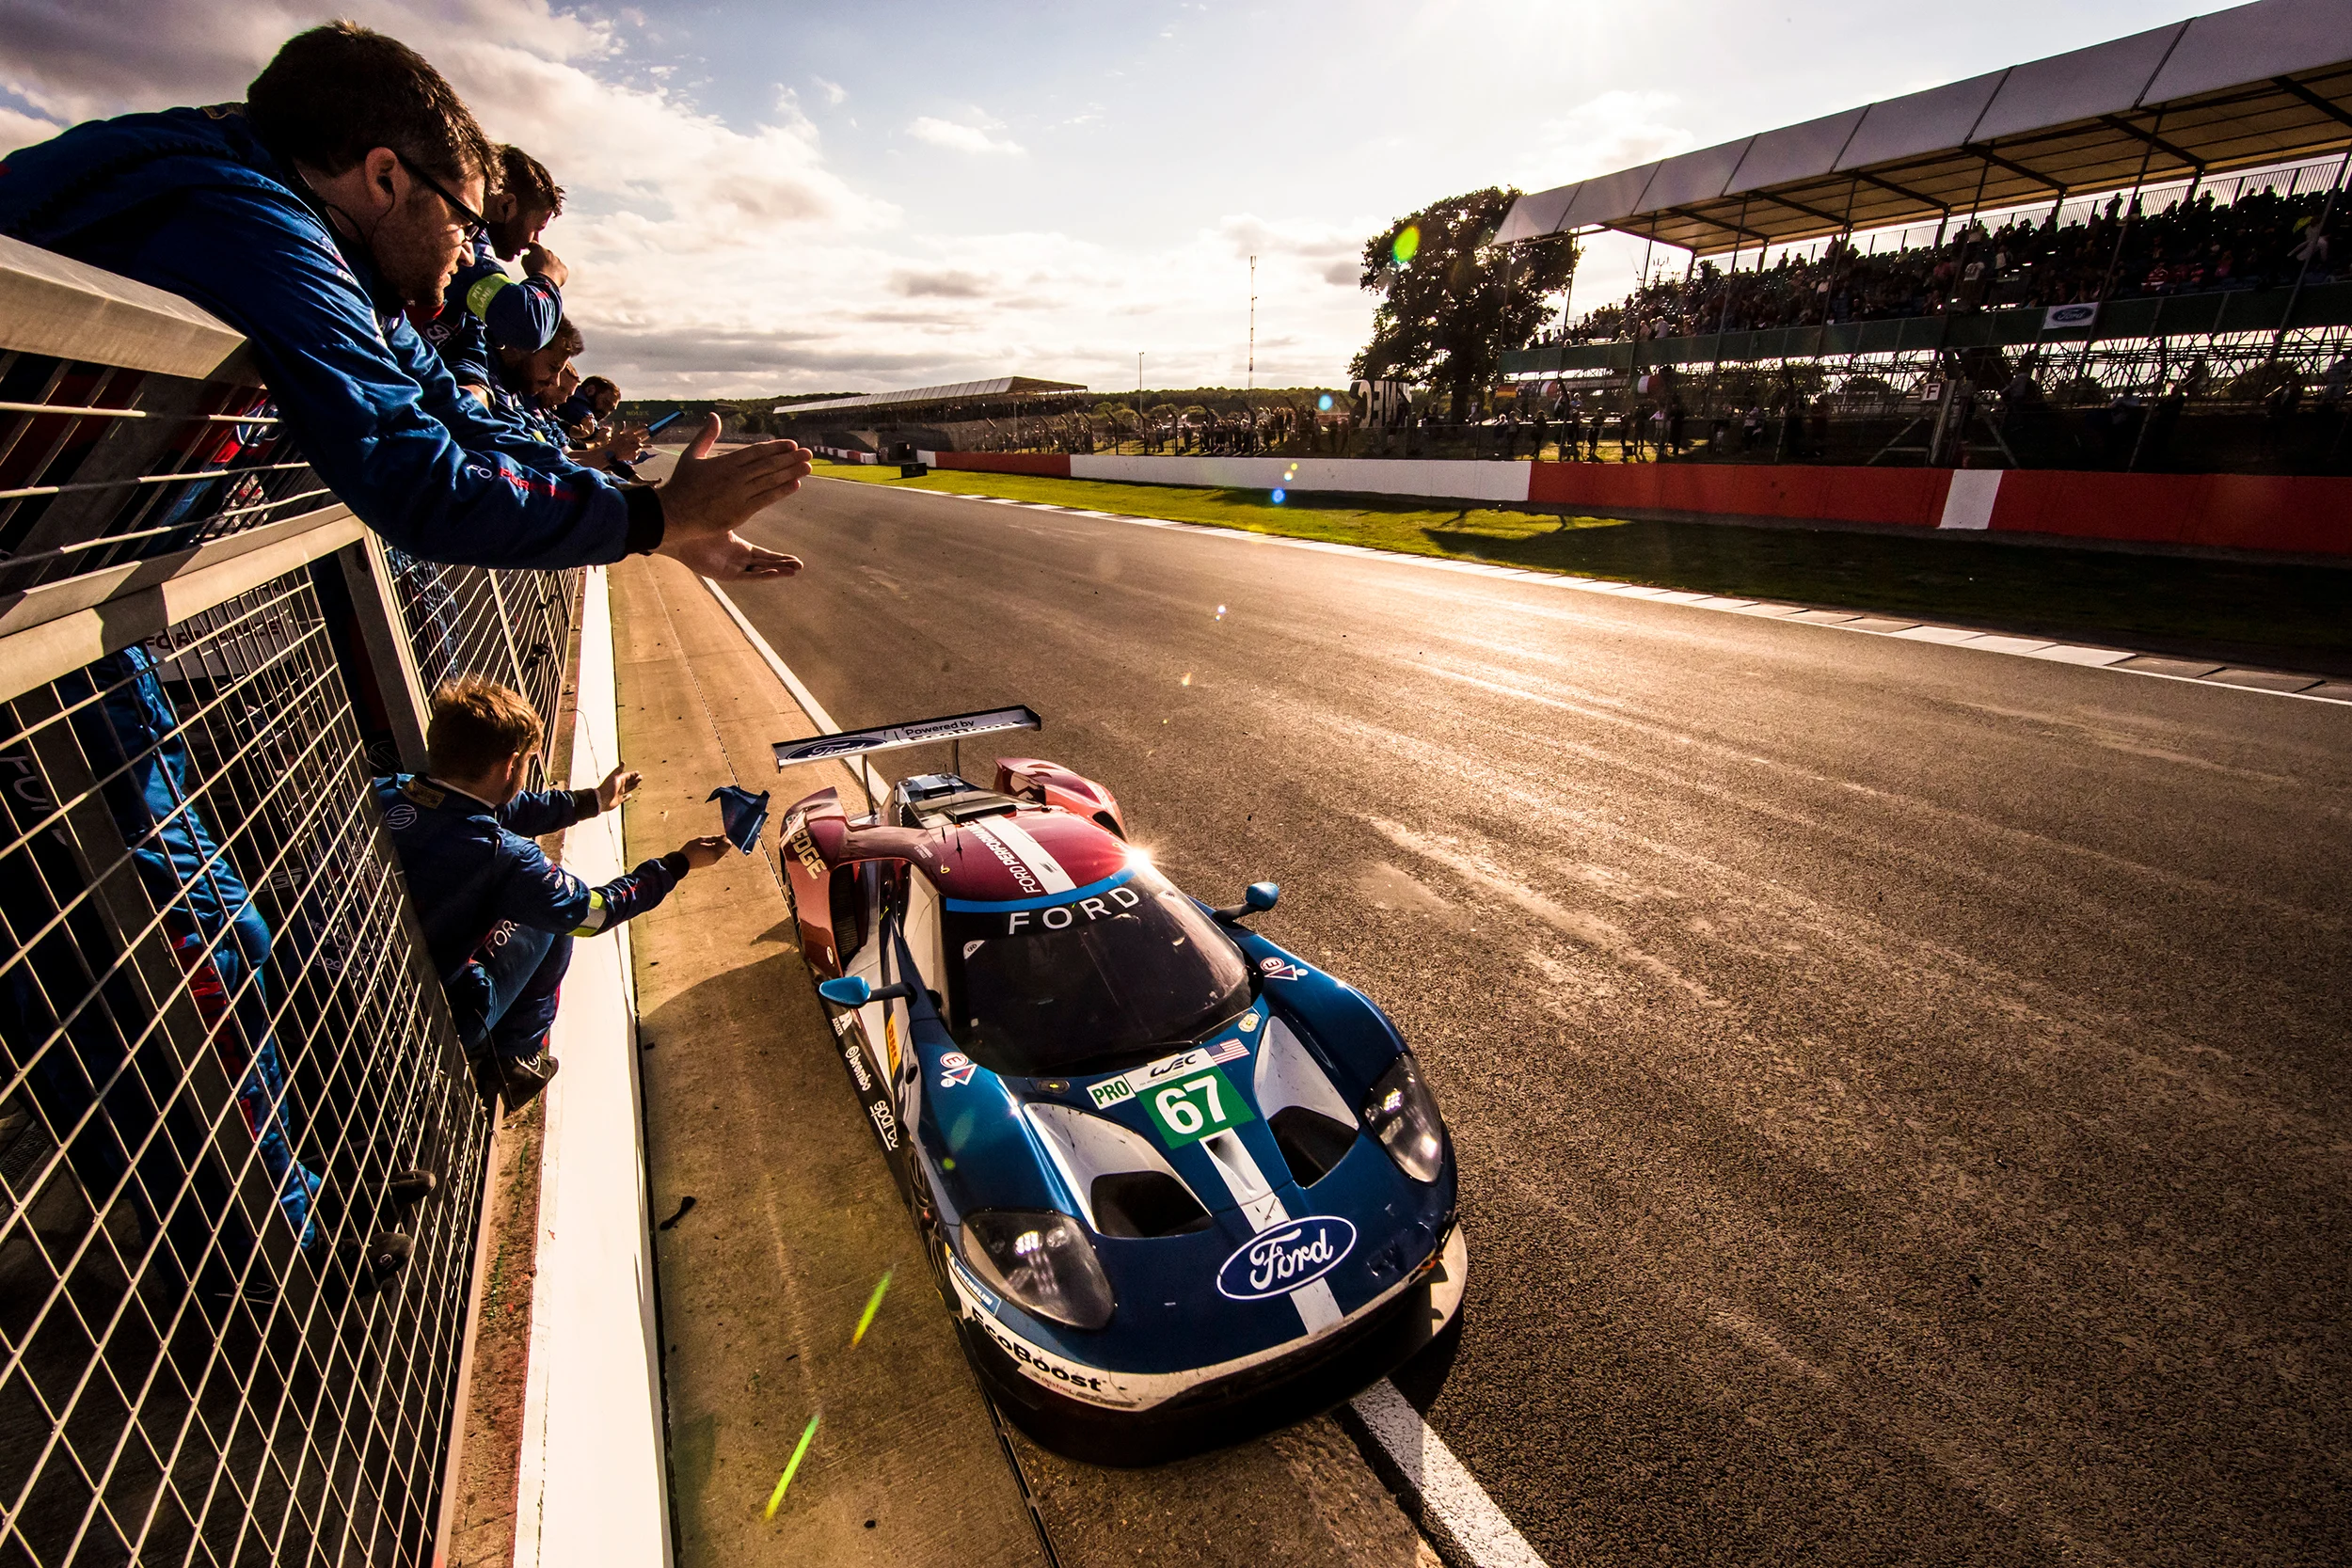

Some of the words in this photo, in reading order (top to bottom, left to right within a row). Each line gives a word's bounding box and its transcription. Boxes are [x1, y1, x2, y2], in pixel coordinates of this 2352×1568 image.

[471, 284, 483, 299] PIT
[478, 287, 494, 309] LANE
[1927, 385, 1939, 398] F
[905, 721, 960, 736] Powered
[961, 719, 975, 731] by
[791, 829, 828, 880] EDGE
[961, 820, 1021, 866] PERFORMANCE
[1009, 864, 1042, 894] FORD
[1009, 887, 1140, 935] FORD
[832, 1018, 844, 1037] AXALTA
[849, 1053, 872, 1092] brembo
[1150, 1053, 1198, 1078] WEC
[1091, 1080, 1131, 1105] PRO
[1154, 1074, 1227, 1134] 67
[1249, 1227, 1334, 1291] Ford
[955, 1264, 993, 1307] MICHELIN
[971, 1306, 1102, 1393] EcoBoost
